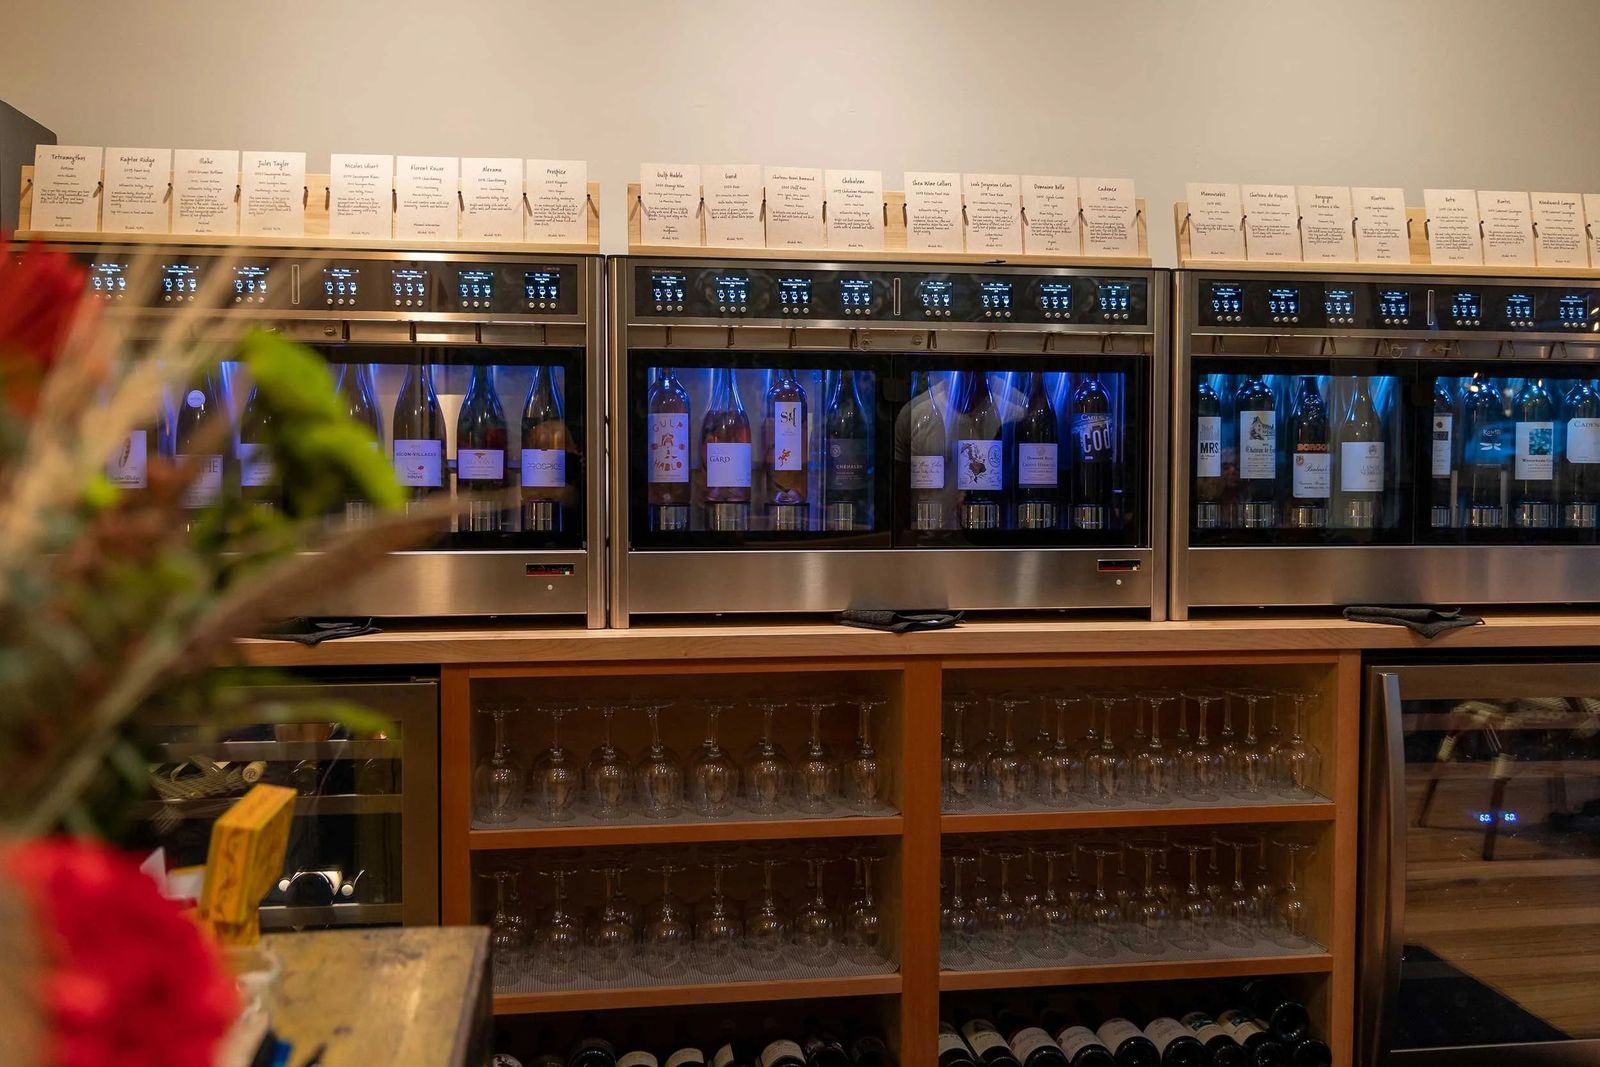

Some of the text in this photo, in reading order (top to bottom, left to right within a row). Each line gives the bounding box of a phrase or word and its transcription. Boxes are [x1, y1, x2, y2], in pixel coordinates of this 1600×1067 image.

[51, 153, 86, 165] Tetramythos
[119, 156, 155, 168] Raptor Ridge
[257, 160, 289, 171] Jules Taylor
[482, 165, 502, 173] Alexana
[546, 168, 567, 177] Prospice
[725, 172, 737, 180] Gard
[1560, 200, 1576, 209] Canyon
[1199, 442, 1220, 454] MRS
[654, 458, 682, 471] HABLO
[709, 456, 731, 464] GARD
